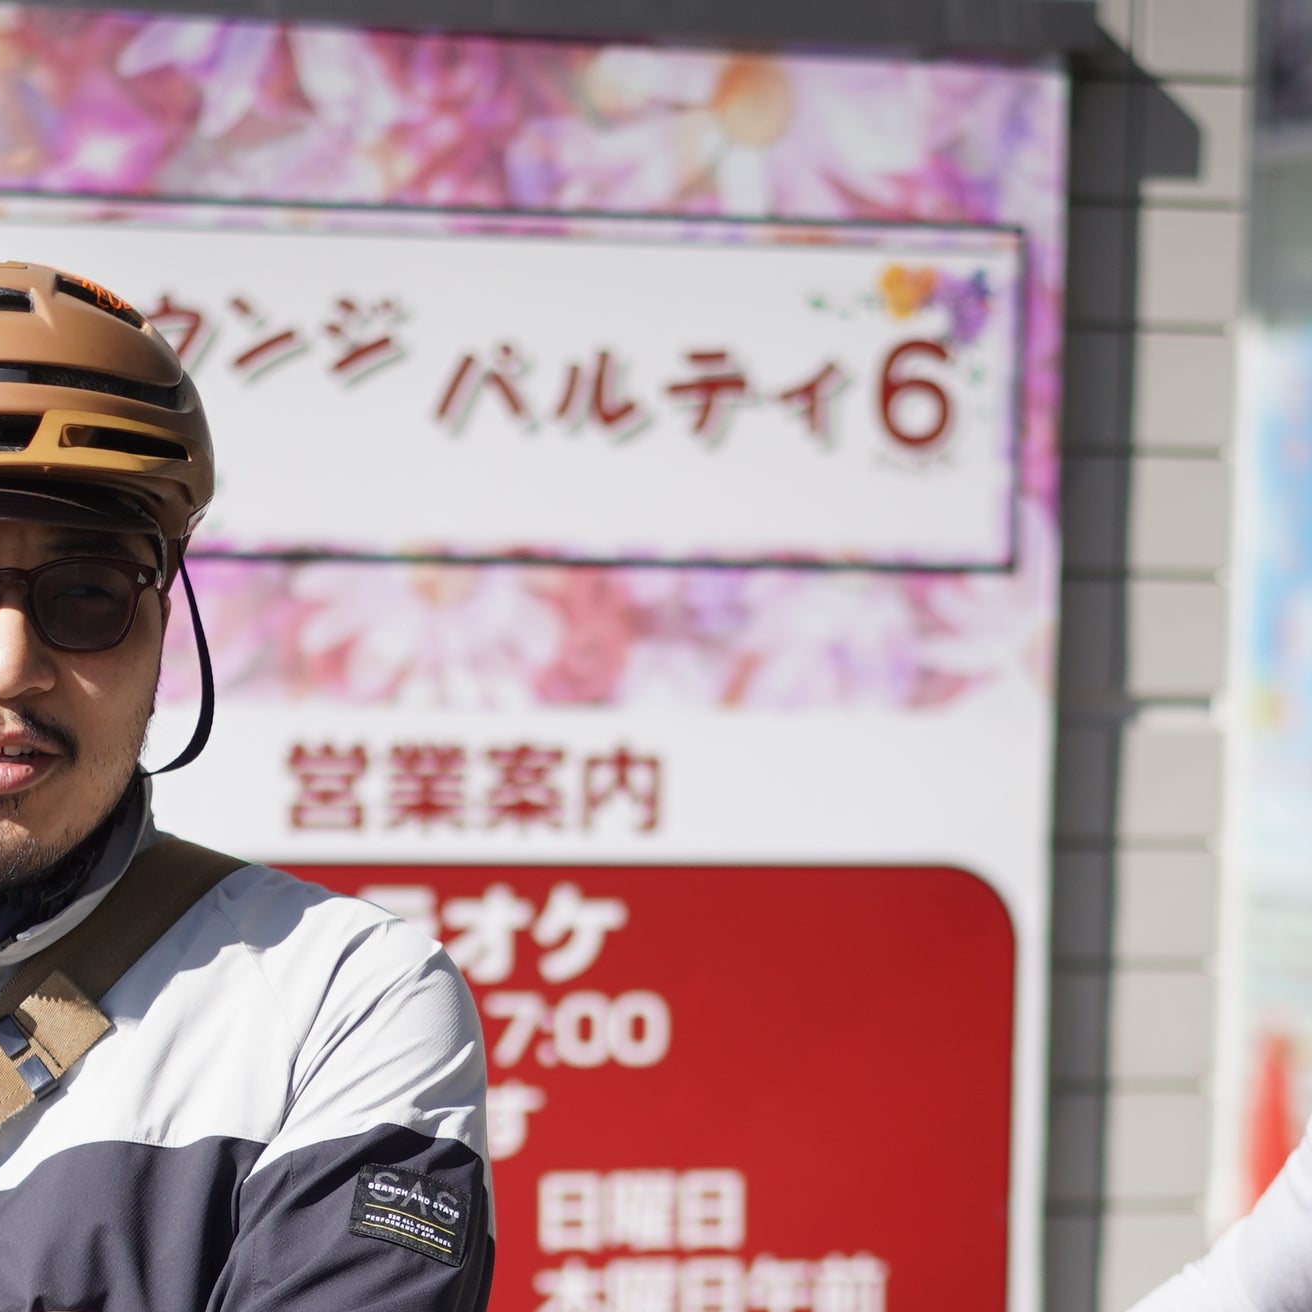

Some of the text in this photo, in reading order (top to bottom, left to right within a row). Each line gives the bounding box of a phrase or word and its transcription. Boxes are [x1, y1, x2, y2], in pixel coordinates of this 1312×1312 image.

[286, 742, 662, 834] 営業案内
[368, 1182, 460, 1219] SEARCH AND STATE
[538, 1170, 748, 1252] 日曜日
[365, 1213, 452, 1248] PERFORMANCE APPAREL
[402, 1217, 414, 1227] ALL
